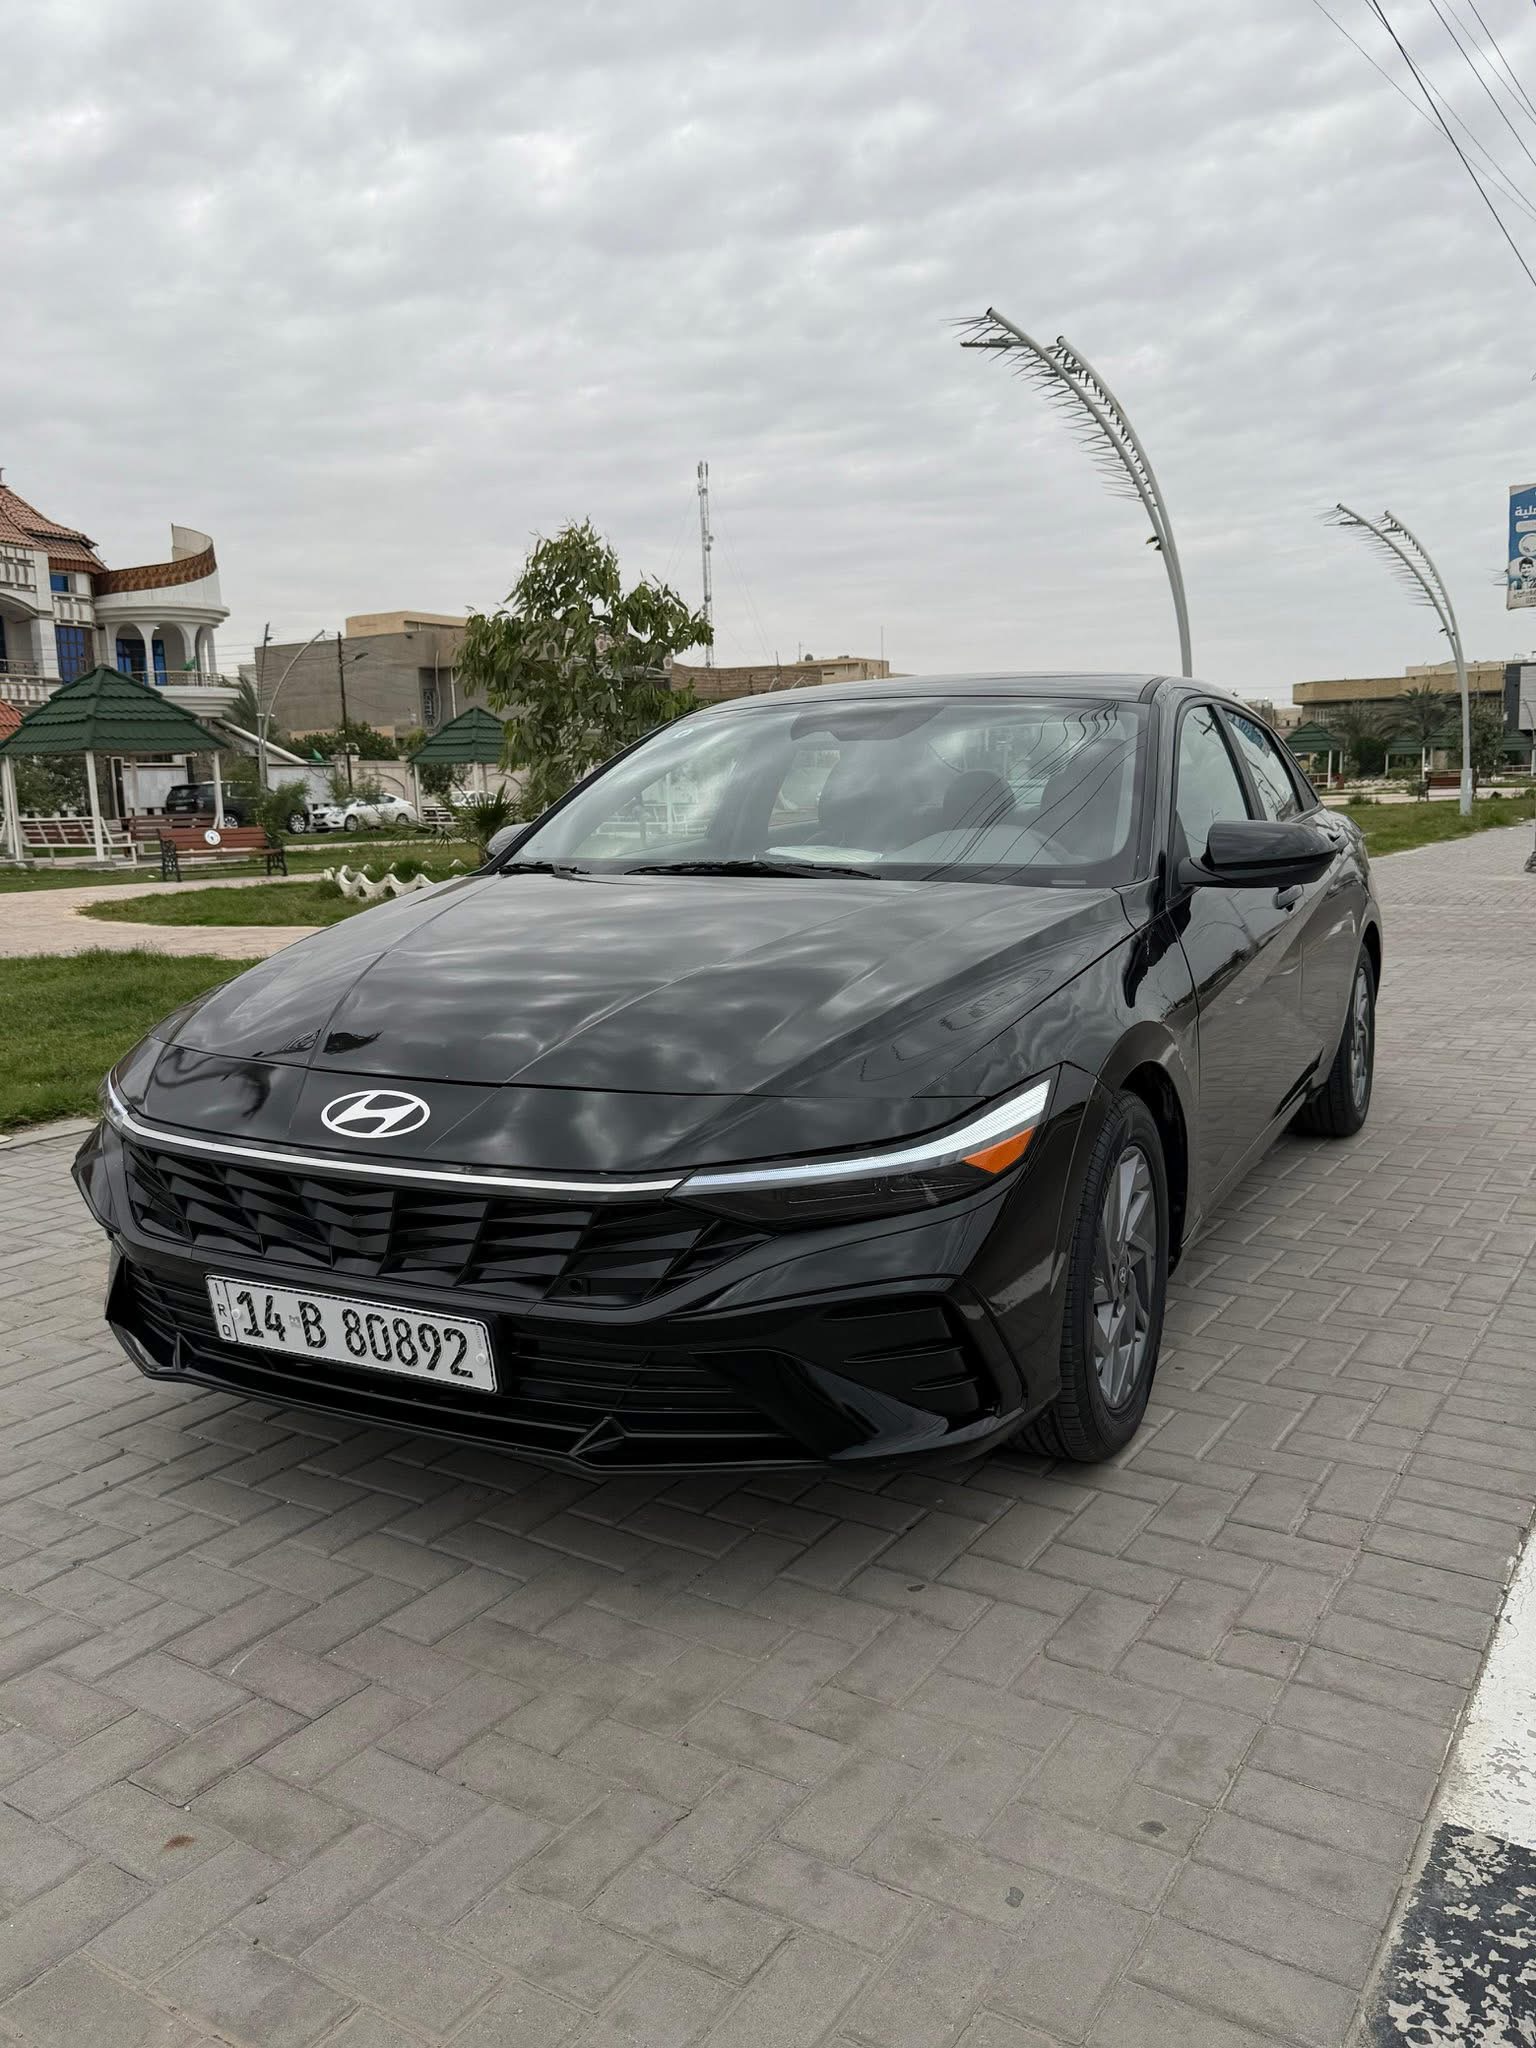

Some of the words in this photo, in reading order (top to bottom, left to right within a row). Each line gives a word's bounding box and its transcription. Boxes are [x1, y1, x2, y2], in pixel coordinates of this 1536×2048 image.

[236, 1291, 287, 1342] 14
[297, 1300, 328, 1349] B
[341, 1308, 474, 1379] 80892
